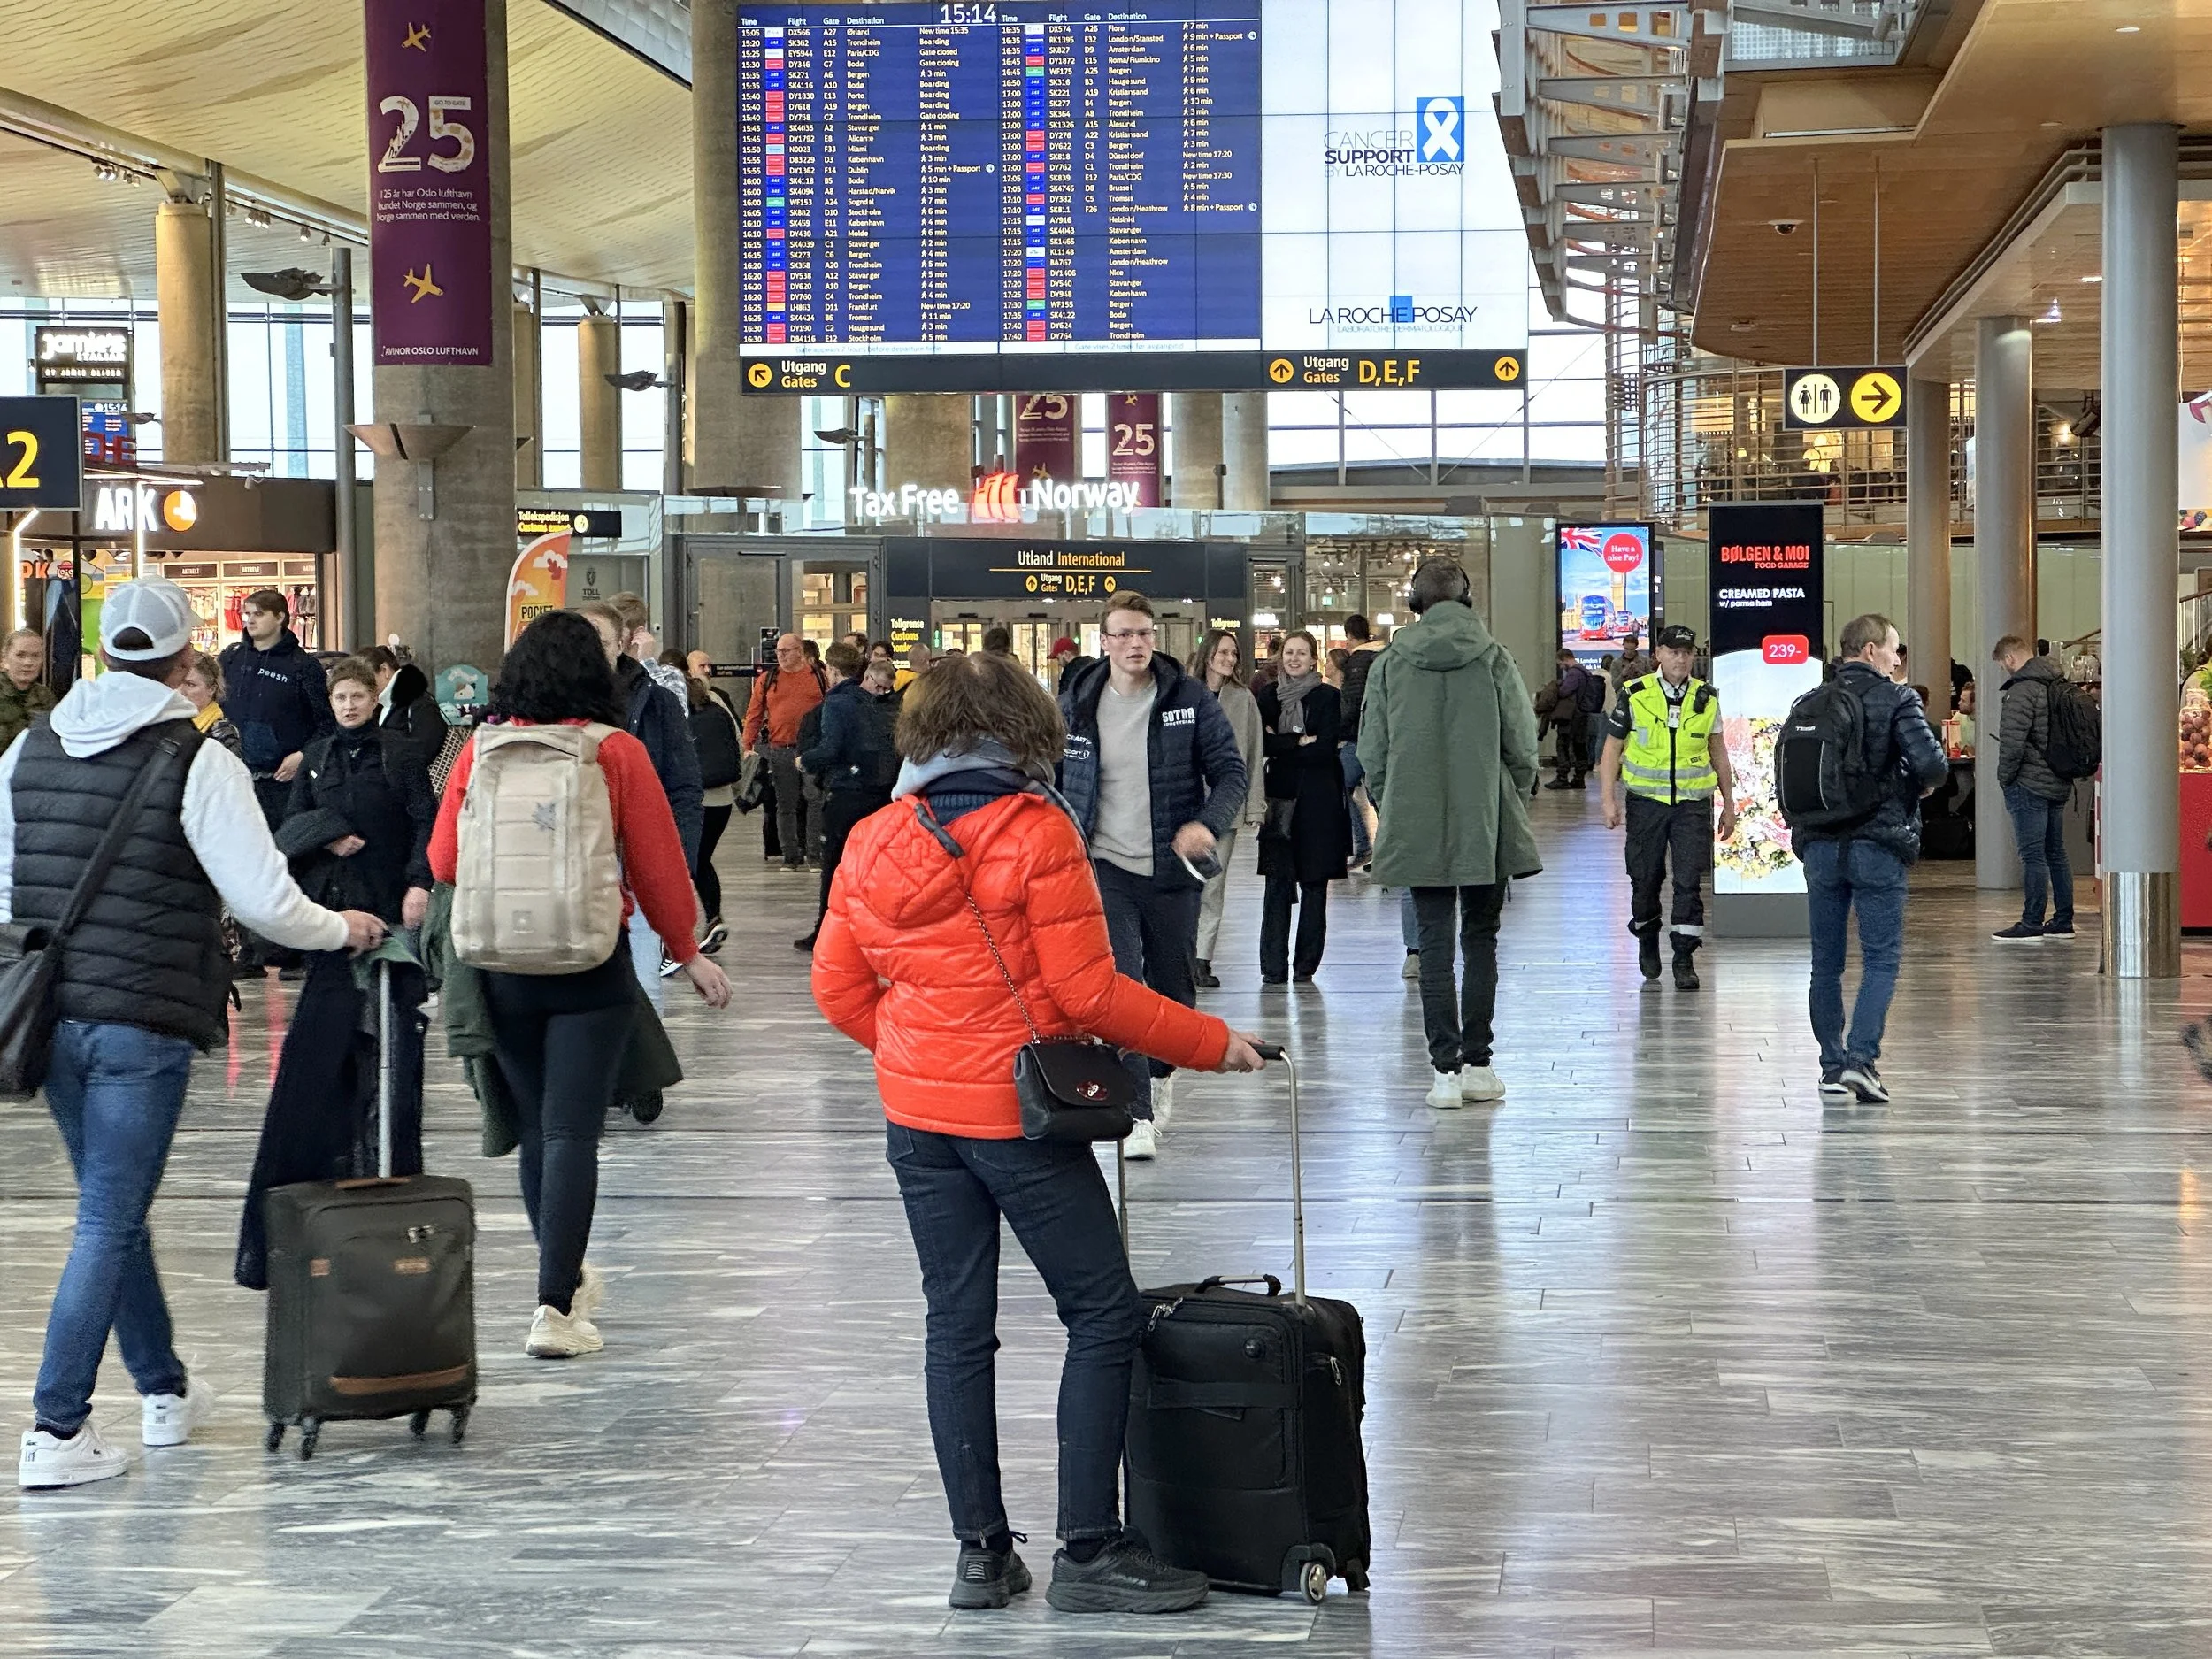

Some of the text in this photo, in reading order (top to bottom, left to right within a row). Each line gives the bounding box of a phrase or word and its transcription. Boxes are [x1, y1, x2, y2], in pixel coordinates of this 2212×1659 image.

[787, 17, 807, 26] Flight
[941, 4, 996, 24] 15:14
[378, 96, 475, 173] 25
[1324, 131, 1414, 150] CANCER
[1325, 149, 1414, 165] SUPPORT
[1325, 164, 1464, 177] BY LA ROCHE-POSAY
[394, 188, 400, 198] år
[402, 188, 414, 197] har
[417, 188, 437, 197] Oslo
[439, 188, 472, 198] lufthavn
[402, 201, 426, 210] Norge
[467, 203, 477, 211] og
[376, 211, 480, 222] Norge sammen med verden.
[1310, 308, 1334, 324] LA
[436, 347, 478, 356] LUFTHAVN
[781, 360, 851, 388] Utgang C
[1303, 356, 1420, 387] Utgang D,E,F
[1303, 371, 1340, 383] Gates
[781, 375, 817, 388] Gates
[1113, 423, 1155, 456] 25
[0, 431, 40, 488] 2
[850, 479, 1139, 518] Tax Free Norway
[95, 487, 159, 531] ARK
[1611, 545, 1629, 554] Have
[1721, 545, 1809, 563] BØLGEN & MOI
[1018, 550, 1125, 567] Utland International
[1624, 554, 1640, 564] Pay!
[1041, 573, 1095, 595] Utgang D,E,F
[1719, 588, 1805, 600] CREAMED PASTA
[891, 631, 919, 641] Customs
[1769, 643, 1801, 658] 239-
[1162, 707, 1195, 723] SOTRA
